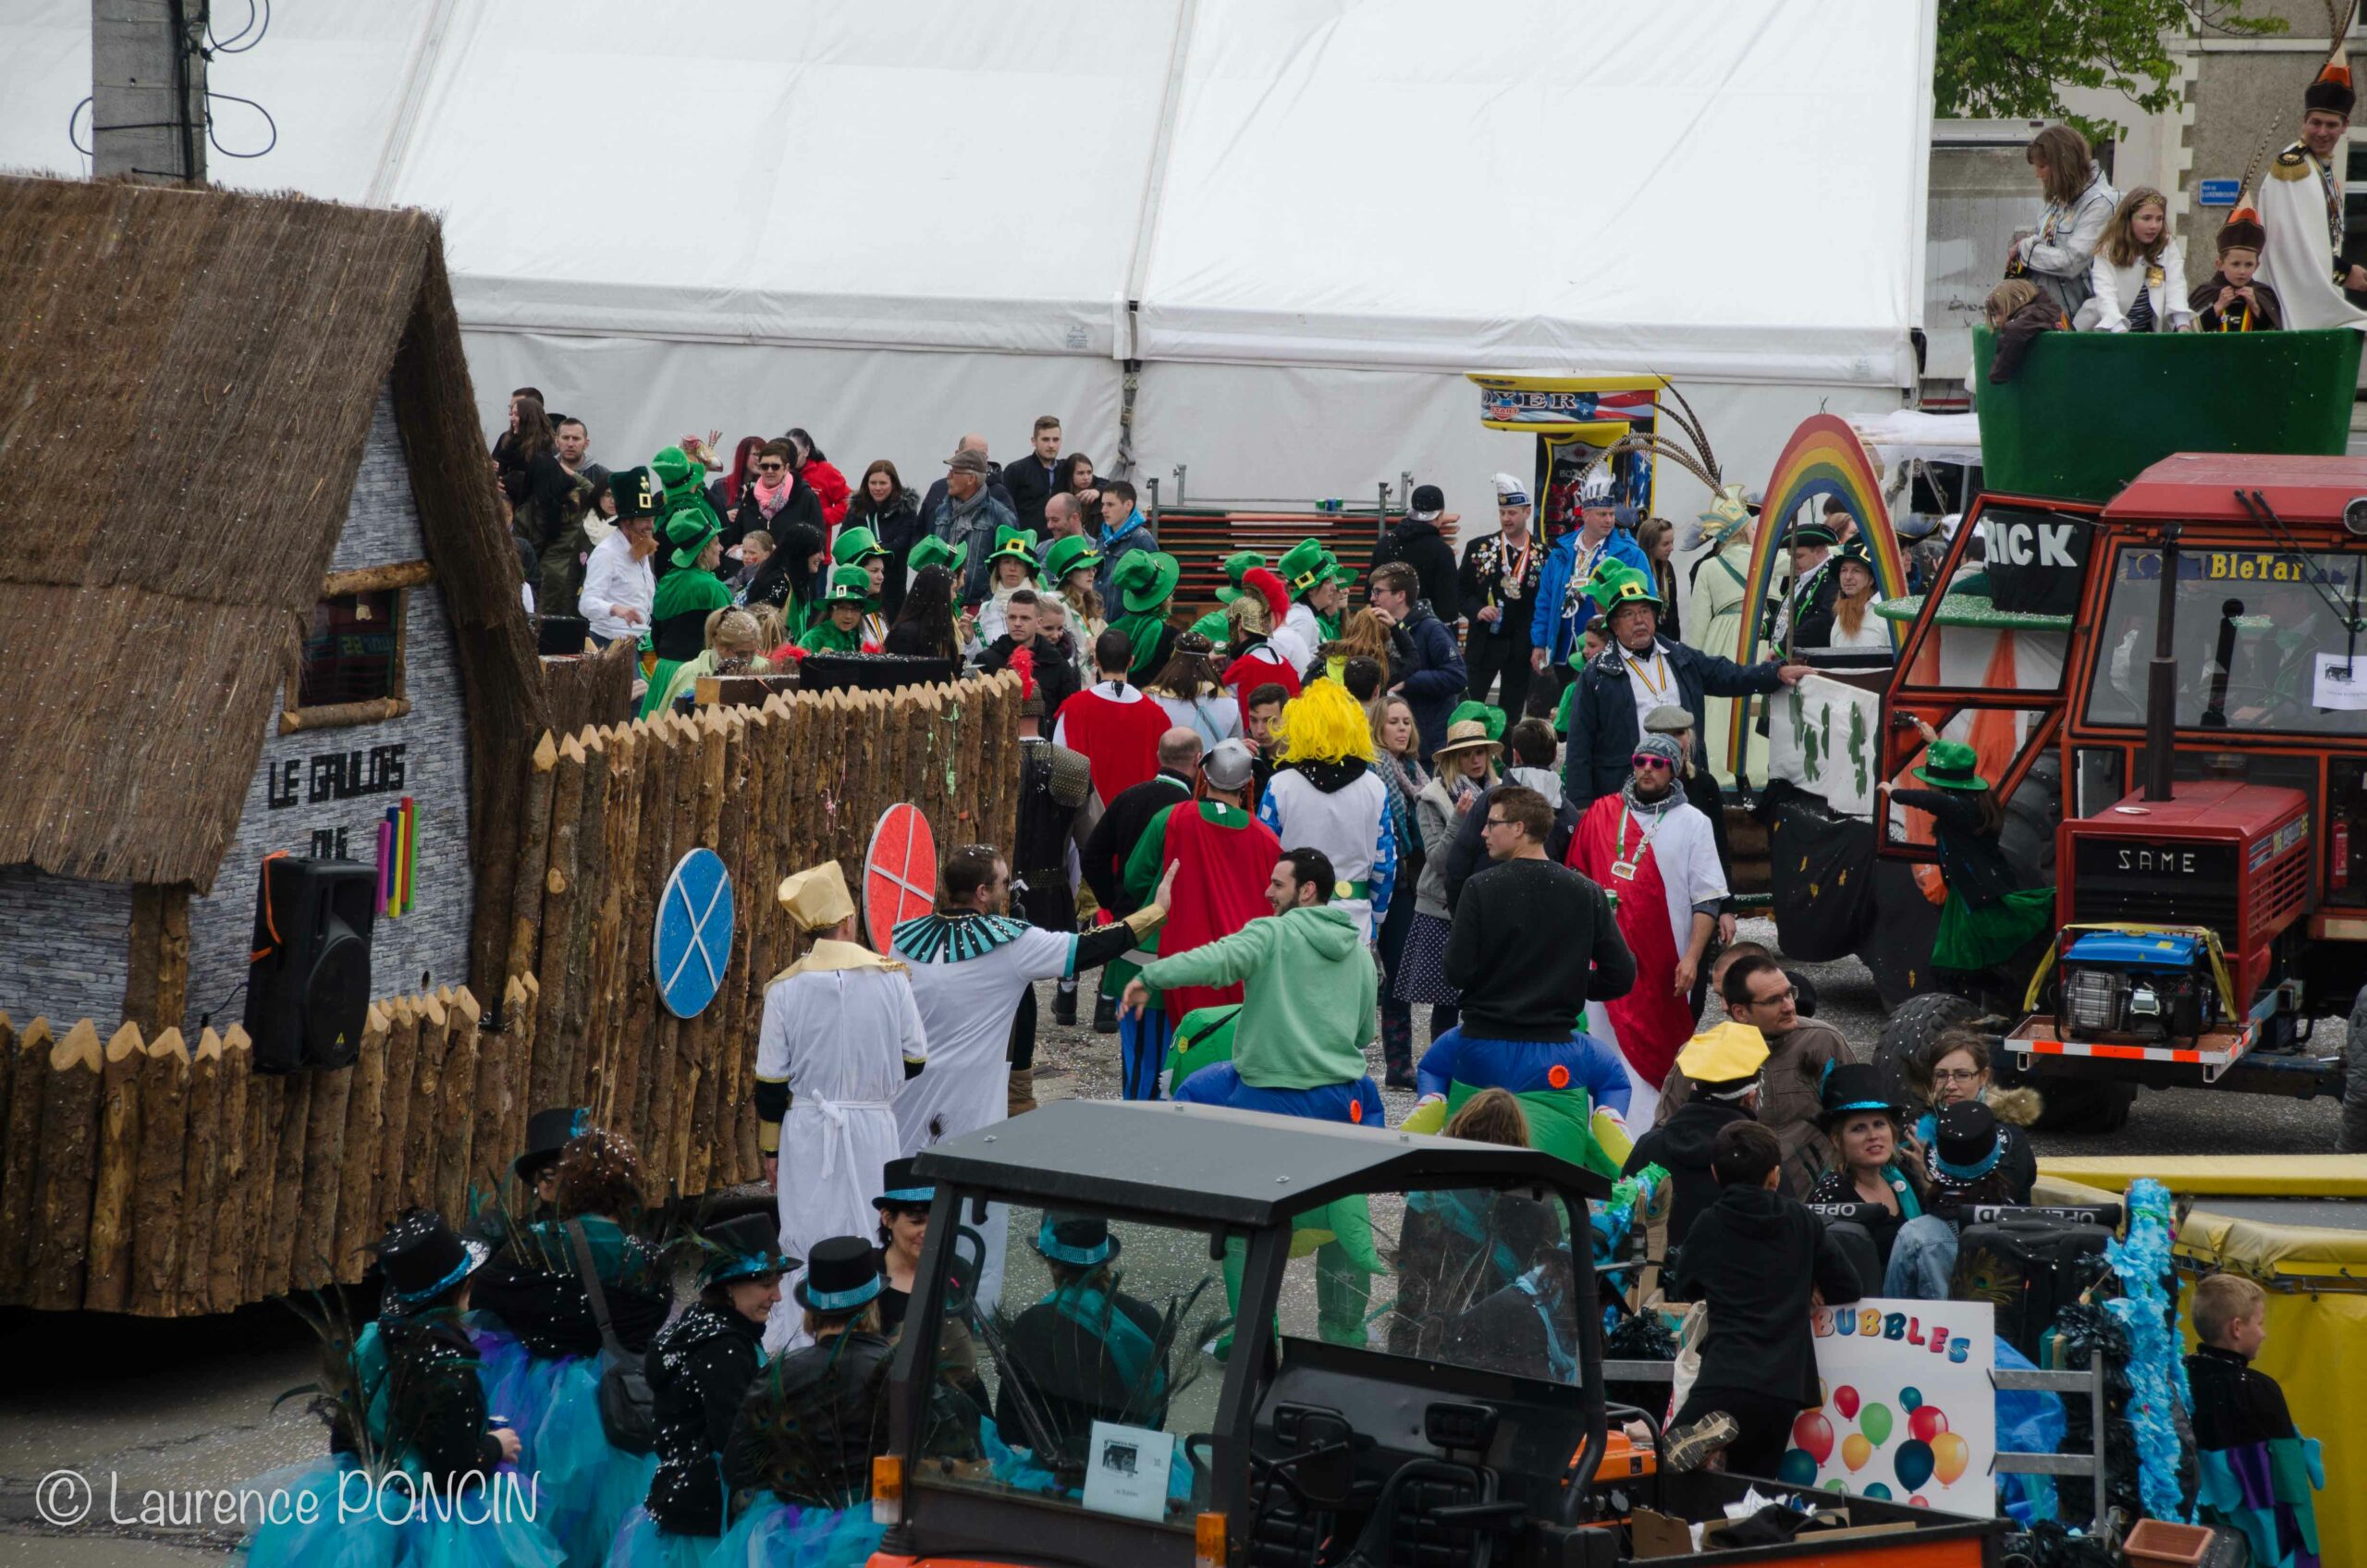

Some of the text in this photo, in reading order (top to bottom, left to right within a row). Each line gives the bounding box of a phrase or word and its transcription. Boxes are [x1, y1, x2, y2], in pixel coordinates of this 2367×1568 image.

[2211, 554, 2304, 581] BleTar
[268, 760, 300, 809] LE
[2118, 850, 2196, 873] SAME
[1811, 1307, 1970, 1364] BUBBLES
